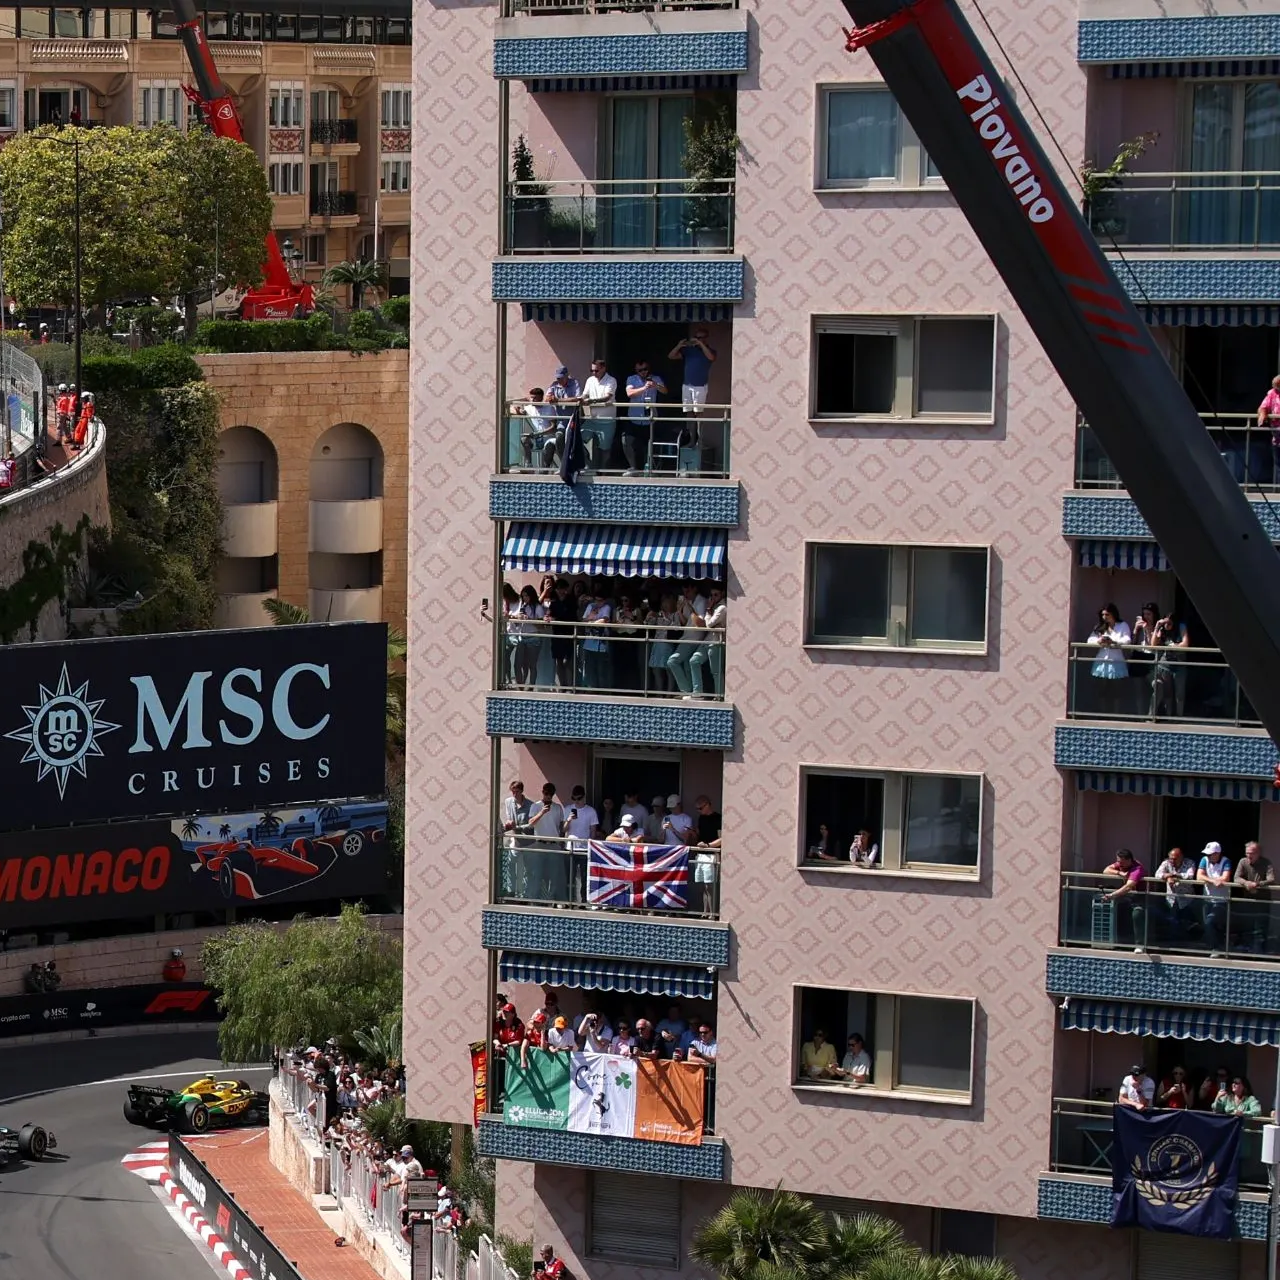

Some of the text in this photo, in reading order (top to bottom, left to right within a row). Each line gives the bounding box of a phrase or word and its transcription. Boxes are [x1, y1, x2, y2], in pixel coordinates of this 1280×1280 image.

[956, 74, 1055, 223] Piovano
[128, 662, 331, 754] MSC
[128, 757, 332, 795] CRUISES
